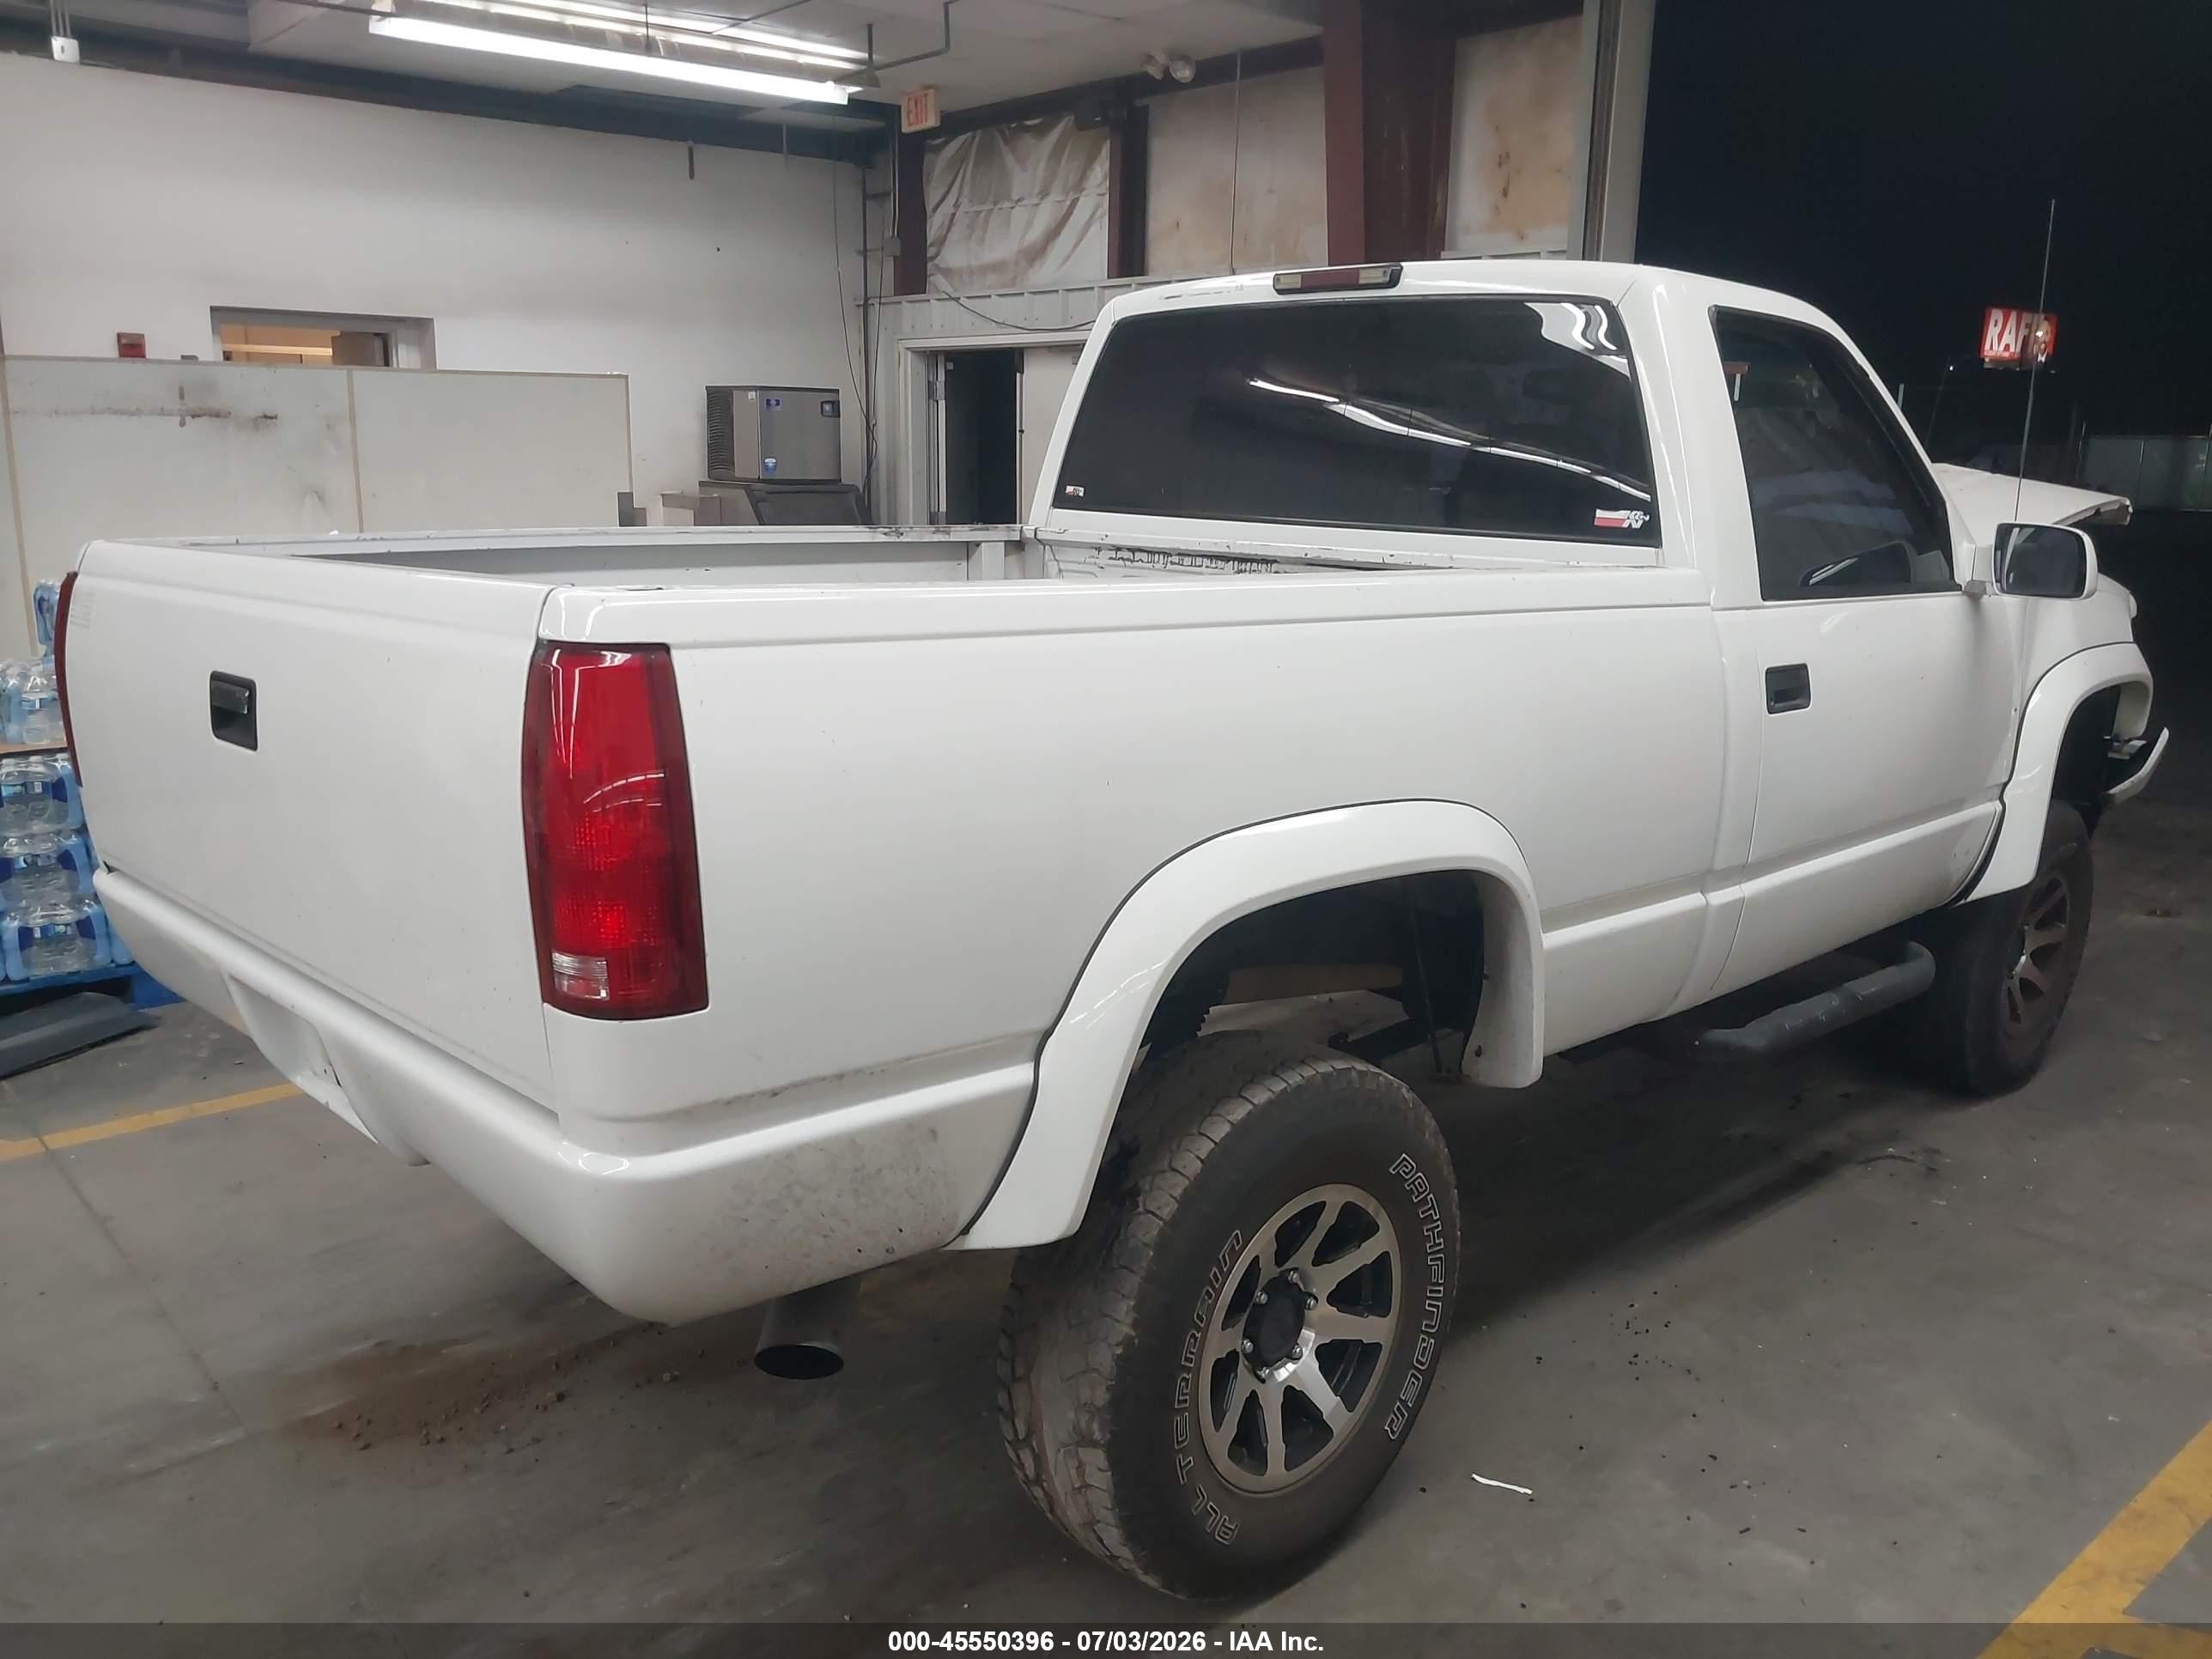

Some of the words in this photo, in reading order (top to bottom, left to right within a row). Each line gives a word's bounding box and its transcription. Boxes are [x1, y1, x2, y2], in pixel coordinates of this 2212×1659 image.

[906, 94, 929, 127] EXIT
[1173, 1229, 1243, 1485] TERRAIN
[1383, 1152, 1446, 1441] PATHFINDER
[1192, 1484, 1242, 1546] ALL
